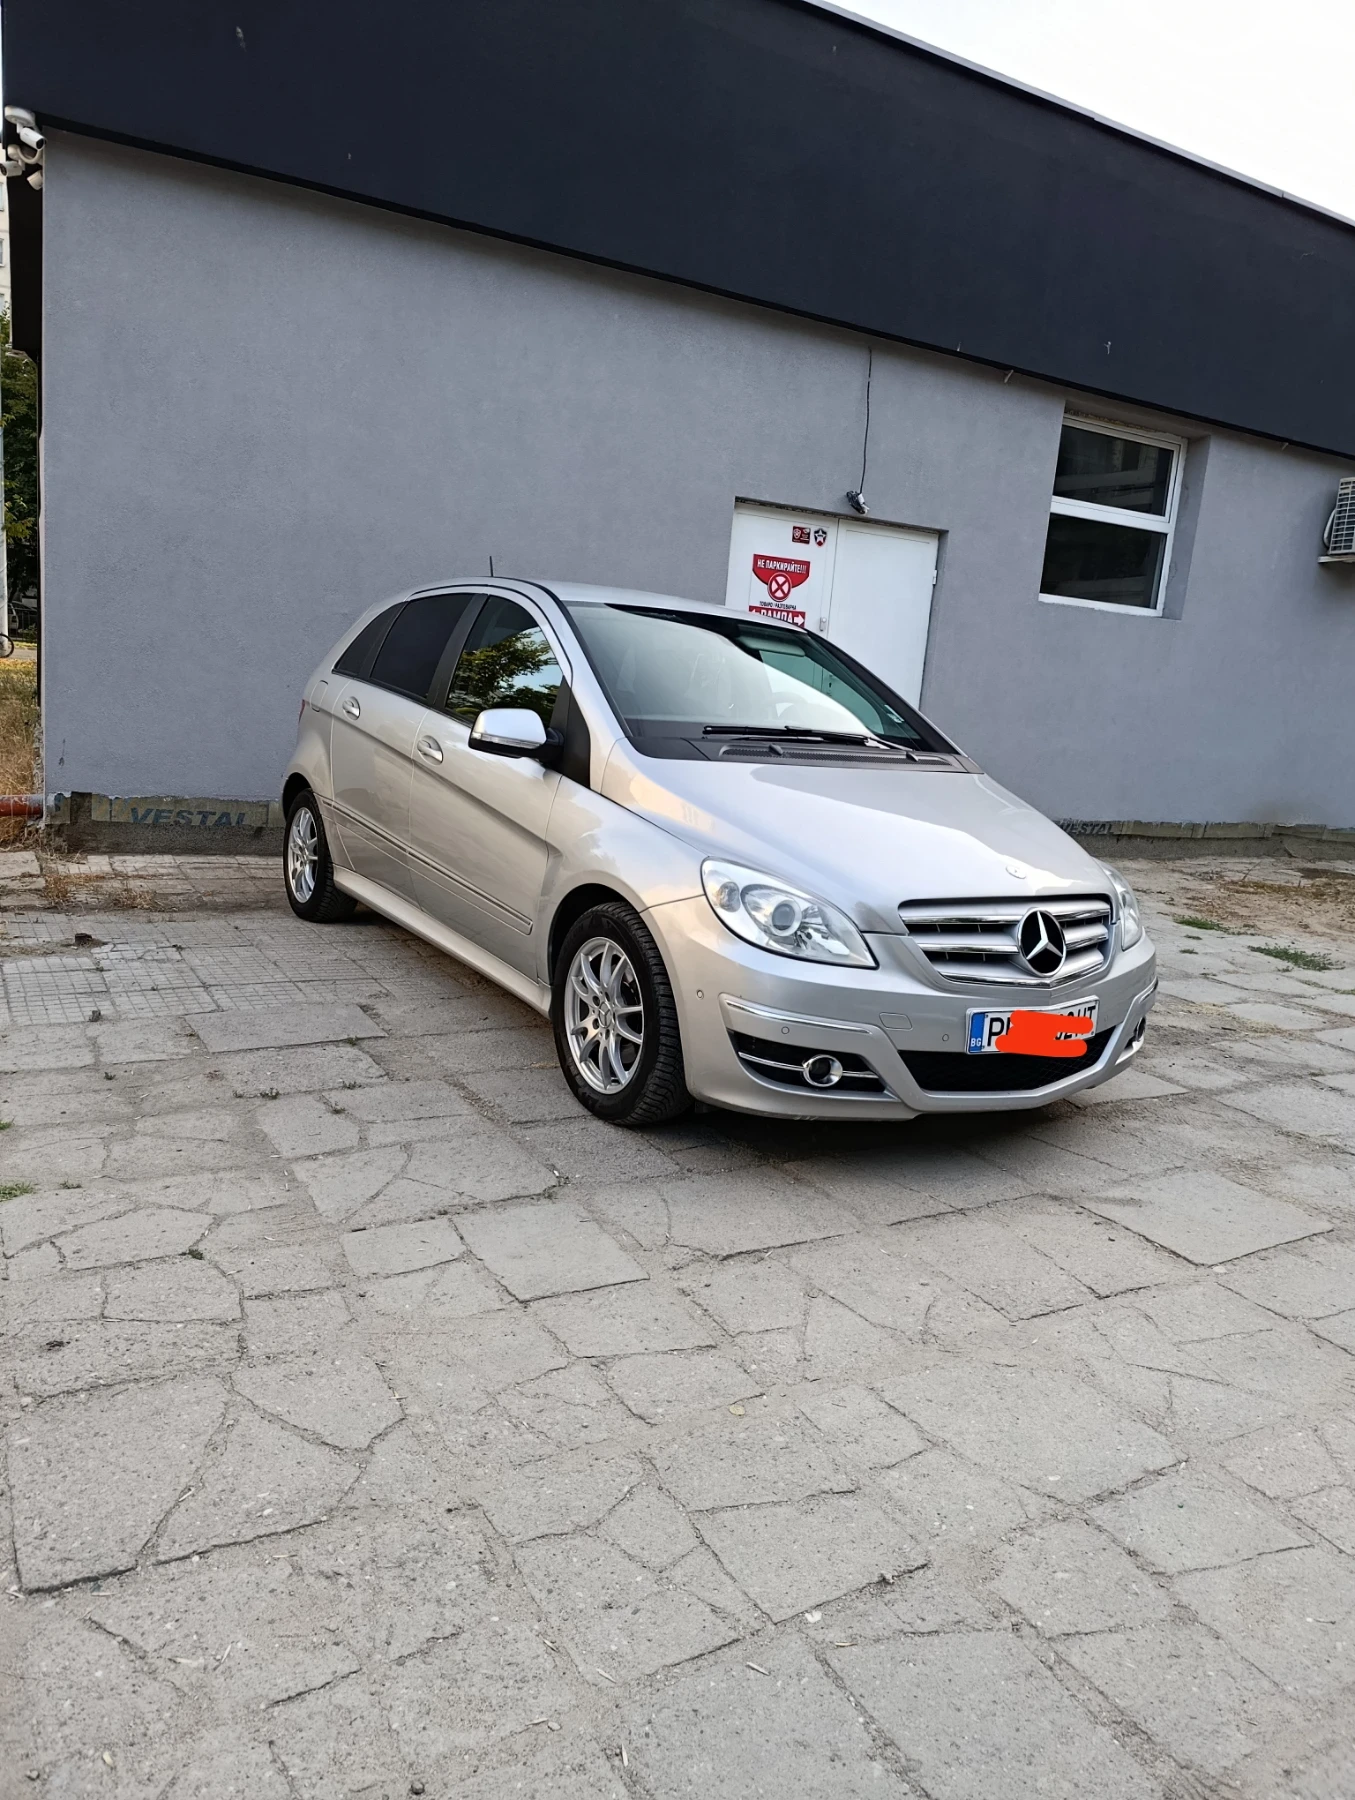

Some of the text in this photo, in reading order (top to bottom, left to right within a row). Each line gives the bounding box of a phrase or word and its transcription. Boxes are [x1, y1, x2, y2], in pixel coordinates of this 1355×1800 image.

[757, 559, 807, 574] НЕ ПАРКИРАЙТЕ!!!
[970, 1037, 982, 1047] BG
